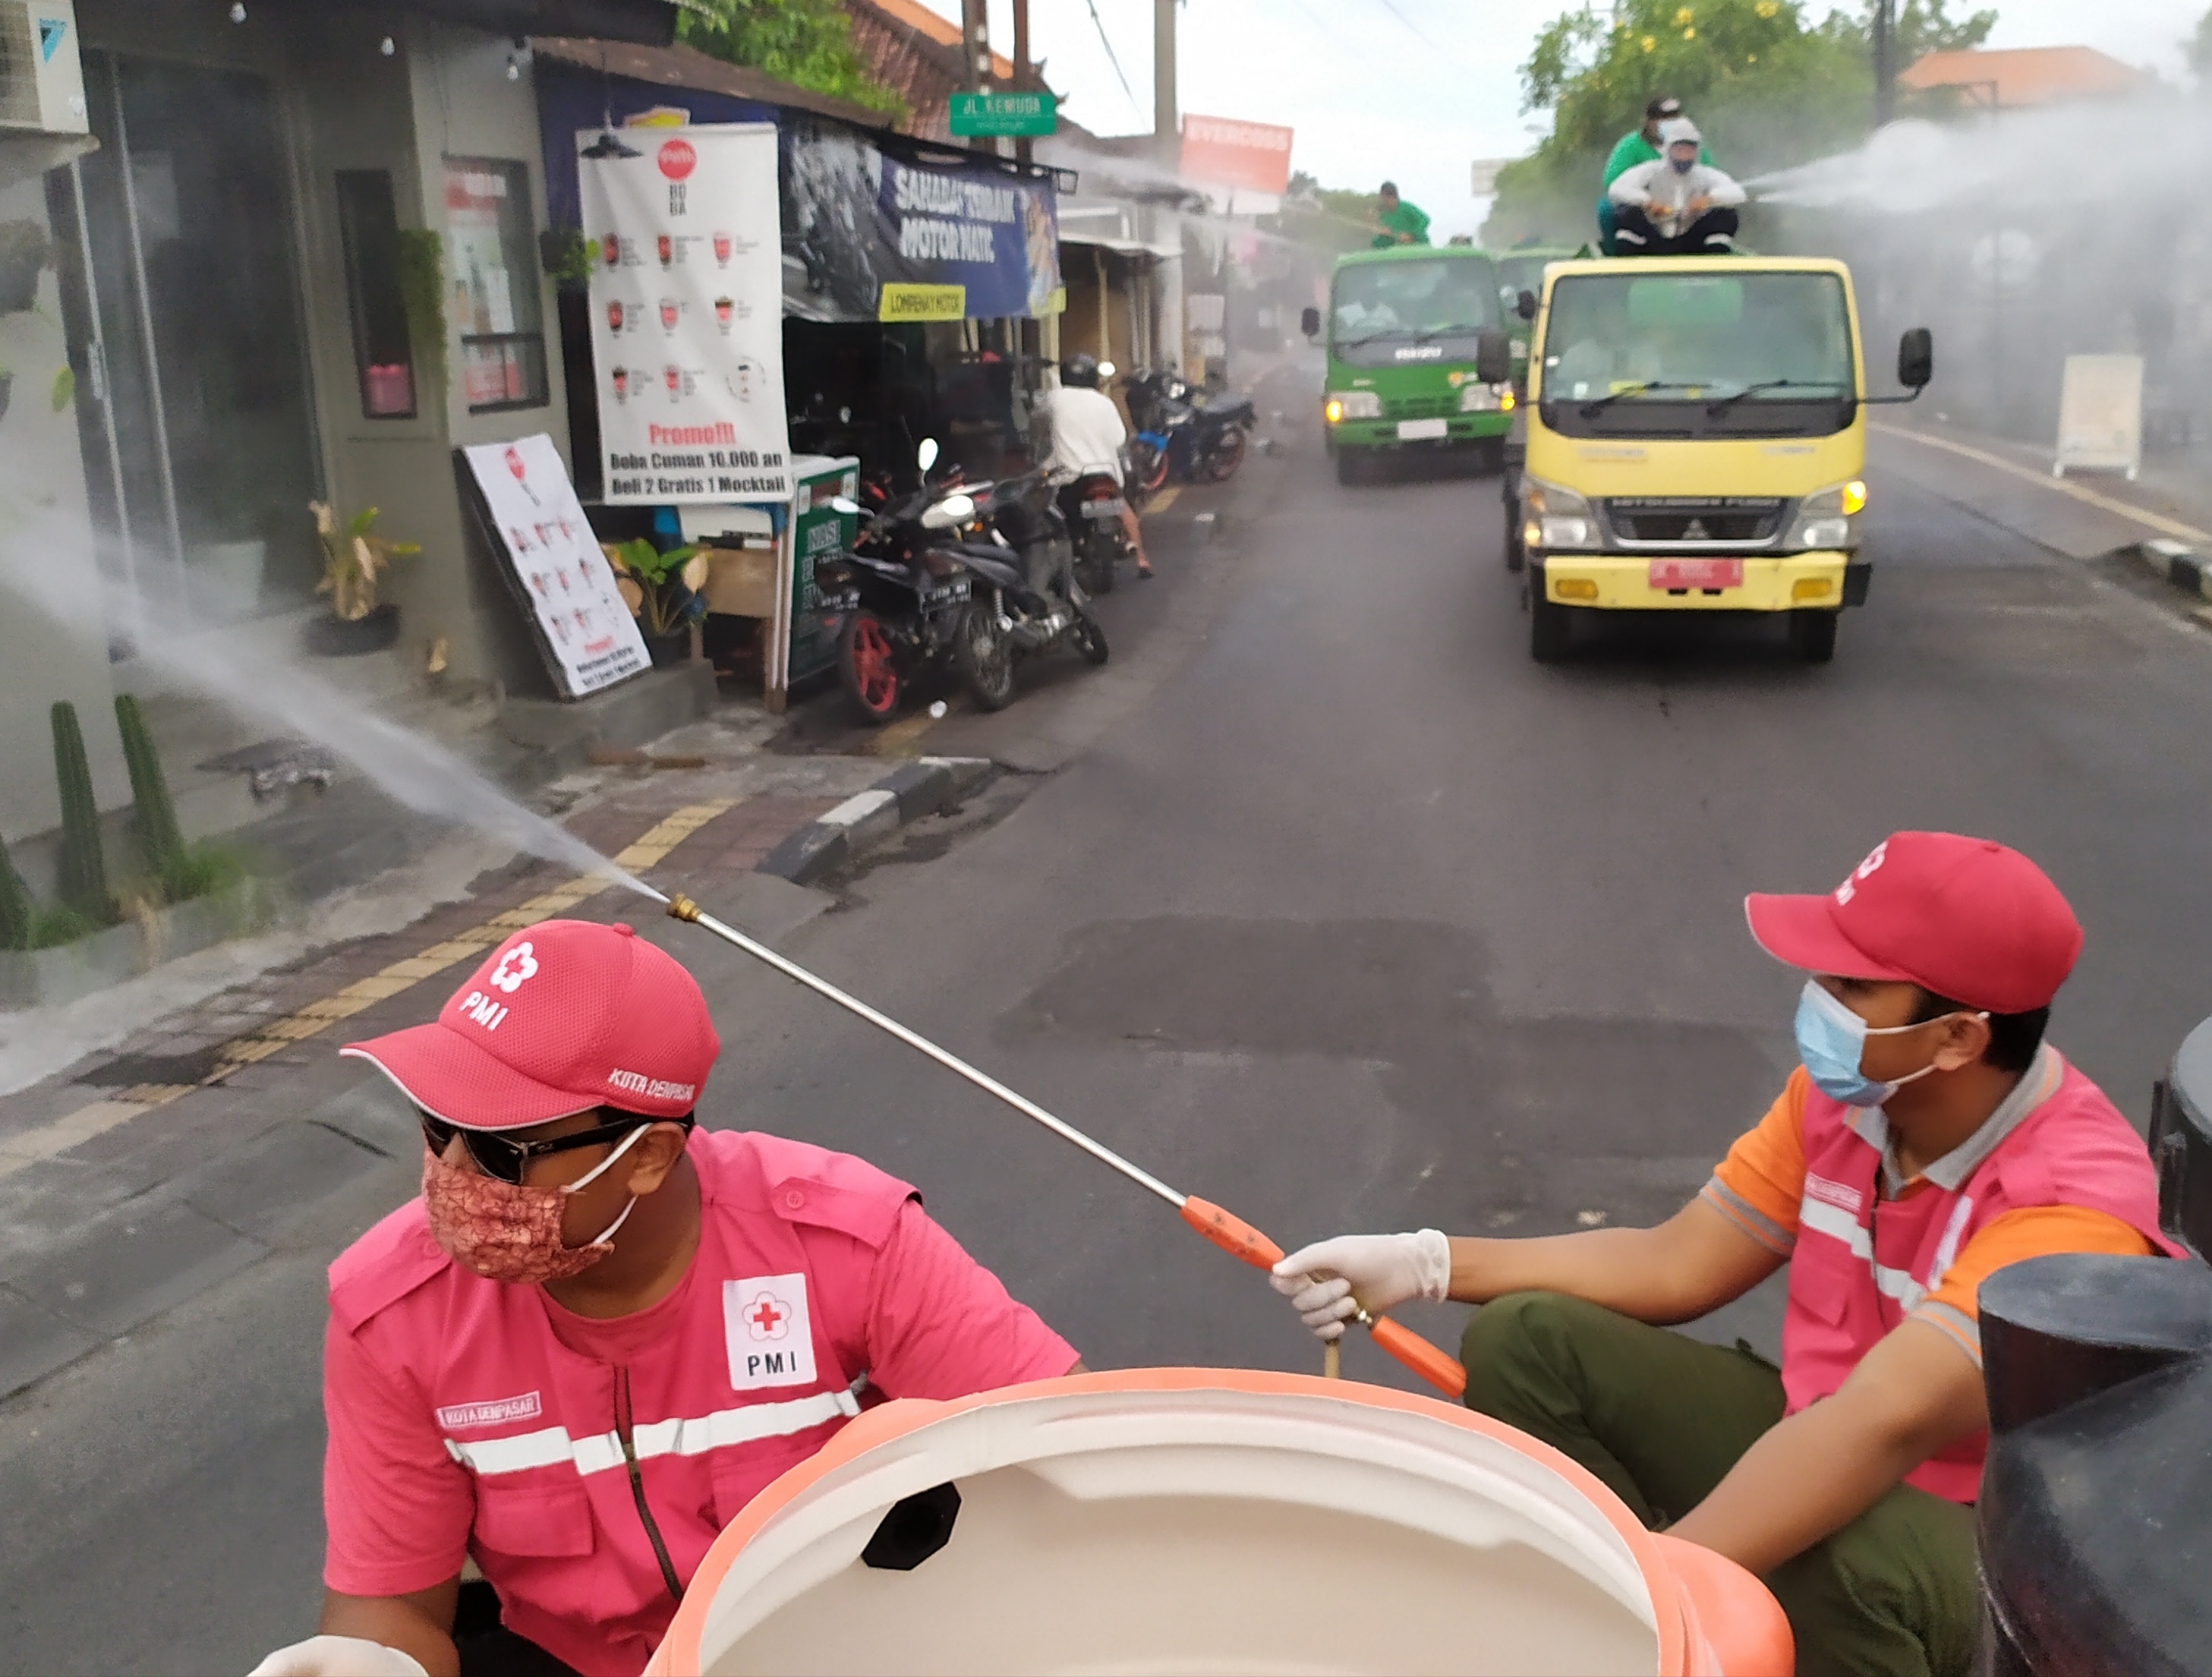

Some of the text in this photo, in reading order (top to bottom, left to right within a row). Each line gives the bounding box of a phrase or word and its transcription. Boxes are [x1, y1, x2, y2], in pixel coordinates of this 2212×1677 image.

[900, 216, 959, 261] MOTOR
[651, 451, 706, 469] Cuman
[709, 450, 759, 469] 10.000
[763, 452, 782, 468] an
[658, 475, 704, 494] Gratis
[718, 474, 786, 493] Mocktail
[459, 991, 509, 1032] PMI
[607, 1067, 648, 1093] KOTA
[747, 1350, 797, 1377] PMI
